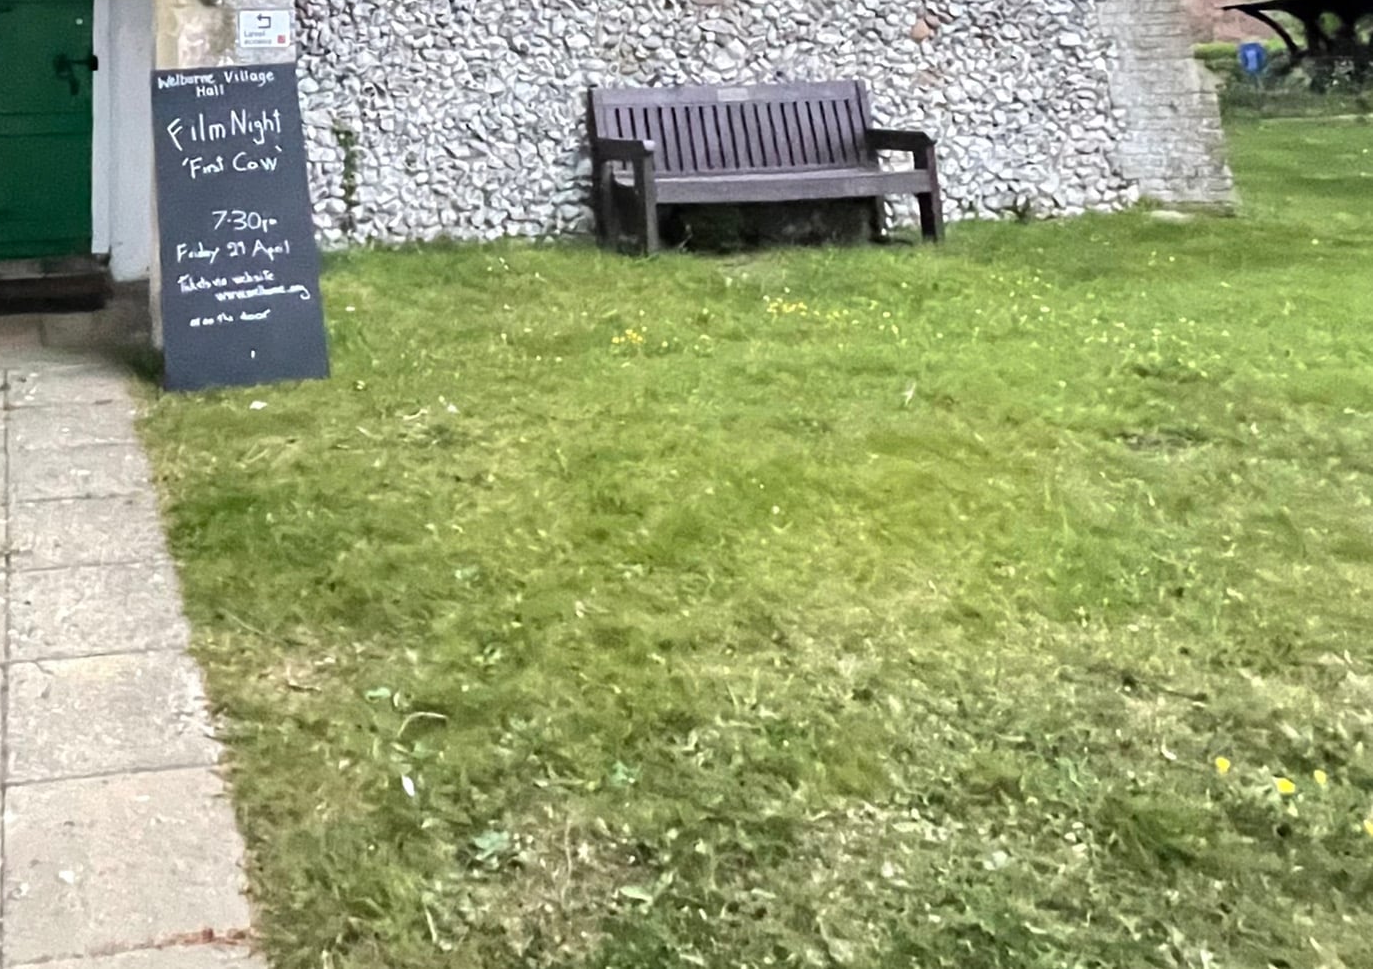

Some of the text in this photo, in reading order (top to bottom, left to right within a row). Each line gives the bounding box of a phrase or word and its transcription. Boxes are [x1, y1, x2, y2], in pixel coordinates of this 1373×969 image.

[224, 70, 275, 87] Village
[195, 84, 225, 97] Hall
[167, 108, 281, 151] Film Night
[227, 240, 246, 257] 29
[252, 239, 290, 261] April
[239, 308, 272, 321] door
